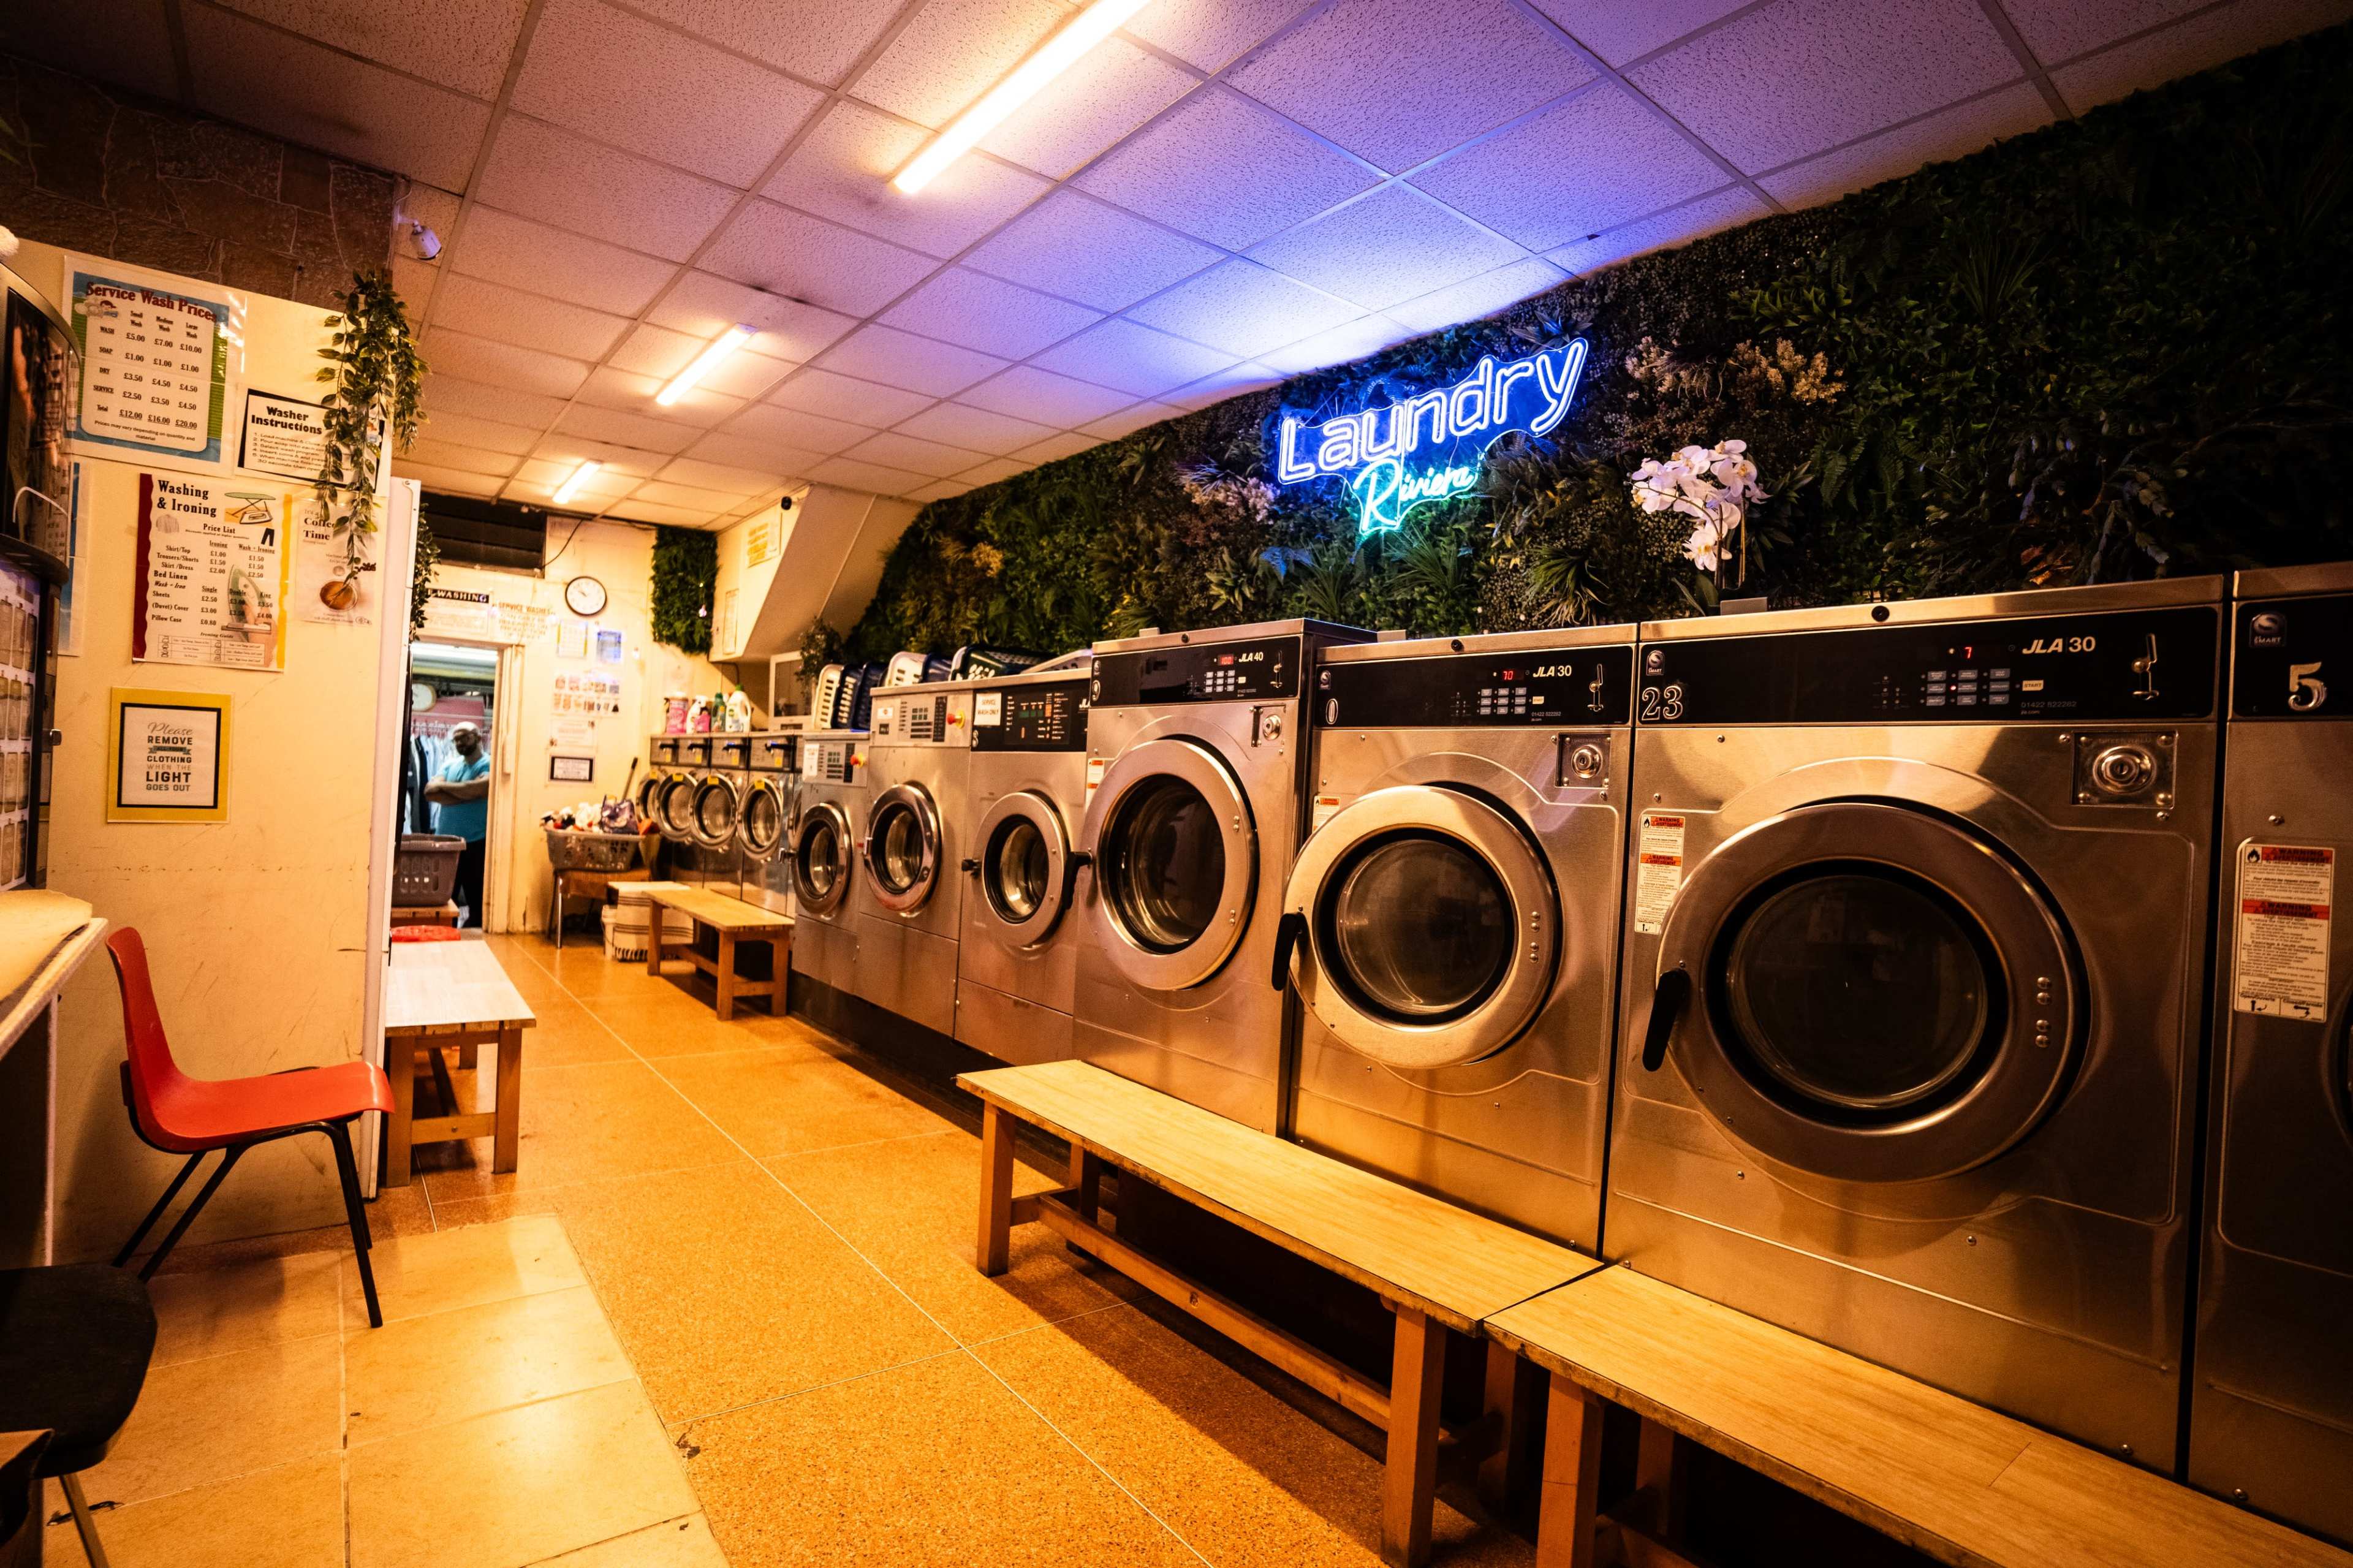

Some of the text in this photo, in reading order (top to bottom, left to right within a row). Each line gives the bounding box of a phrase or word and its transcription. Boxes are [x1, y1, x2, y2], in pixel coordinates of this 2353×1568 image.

[86, 281, 217, 322] Service Wash Prices
[100, 326, 202, 354] WASH £5.00 £7.00 £10.00
[124, 352, 144, 362] £1.00
[153, 358, 172, 368] £1.00
[180, 363, 199, 373] £1.00
[123, 373, 143, 382] £3.50
[152, 378, 170, 388] £4.50
[180, 384, 197, 393] £4.50
[93, 385, 197, 411] SERVICE £2.50 £3.50 £4.50
[267, 406, 309, 422] Washer
[1279, 339, 1586, 482] Laundry
[119, 409, 143, 419] £12.00
[148, 414, 170, 425] £16.00
[175, 419, 197, 430] £20.00
[251, 415, 322, 435] Instructions
[157, 480, 209, 500] Washing
[1352, 457, 1476, 531] Riviera
[157, 497, 217, 518] & Ironing
[203, 523, 235, 534] Price List
[303, 529, 330, 540] Time
[165, 545, 191, 554] Shirt/Top
[209, 540, 228, 549] Ironing
[157, 552, 199, 563] Trousers/Shorts
[161, 562, 175, 570] Skirt
[202, 585, 218, 594] Single
[438, 589, 487, 603] WASHING
[2022, 636, 2096, 654] JLA 30
[1238, 651, 1264, 662] JLA 40
[1965, 646, 1972, 659] 7
[1503, 671, 1514, 680] 70
[1533, 665, 1572, 678] JLA 30
[2288, 661, 2327, 711] 5
[1642, 685, 1683, 721] 23
[147, 721, 194, 736] Please
[148, 735, 193, 745] REMOVE
[147, 755, 192, 763] CLOTHING
[146, 771, 191, 782] LIGHT
[2268, 902, 2312, 912] WARNING
